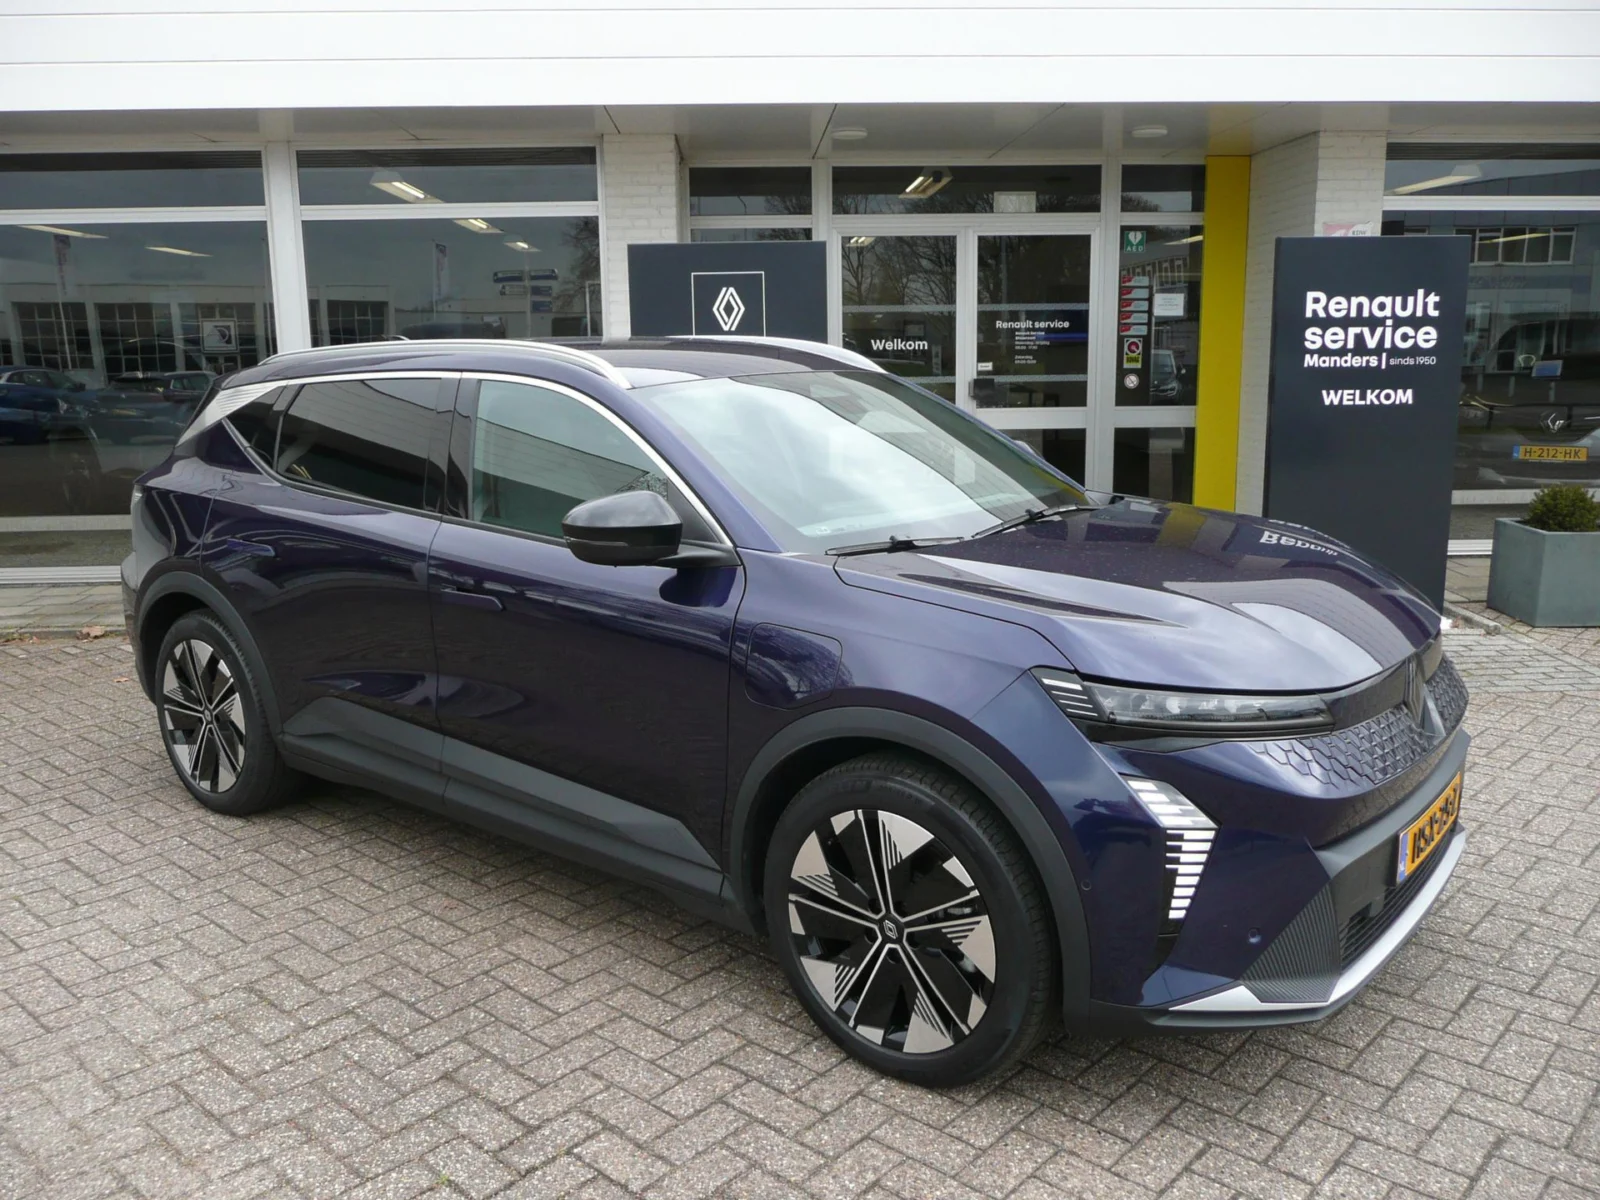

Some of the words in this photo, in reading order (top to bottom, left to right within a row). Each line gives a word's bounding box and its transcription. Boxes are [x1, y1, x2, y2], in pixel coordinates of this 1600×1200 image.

[1305, 288, 1440, 318] Renault
[995, 320, 1033, 329] Renault
[1034, 319, 1070, 328] service
[1304, 319, 1438, 350] service
[871, 338, 928, 351] Welkom
[1303, 352, 1379, 368] Manders
[1389, 356, 1415, 366] sinds
[1415, 356, 1437, 365] 1950
[1321, 388, 1413, 406] WELKOM
[1524, 447, 1581, 460] H-212-HK
